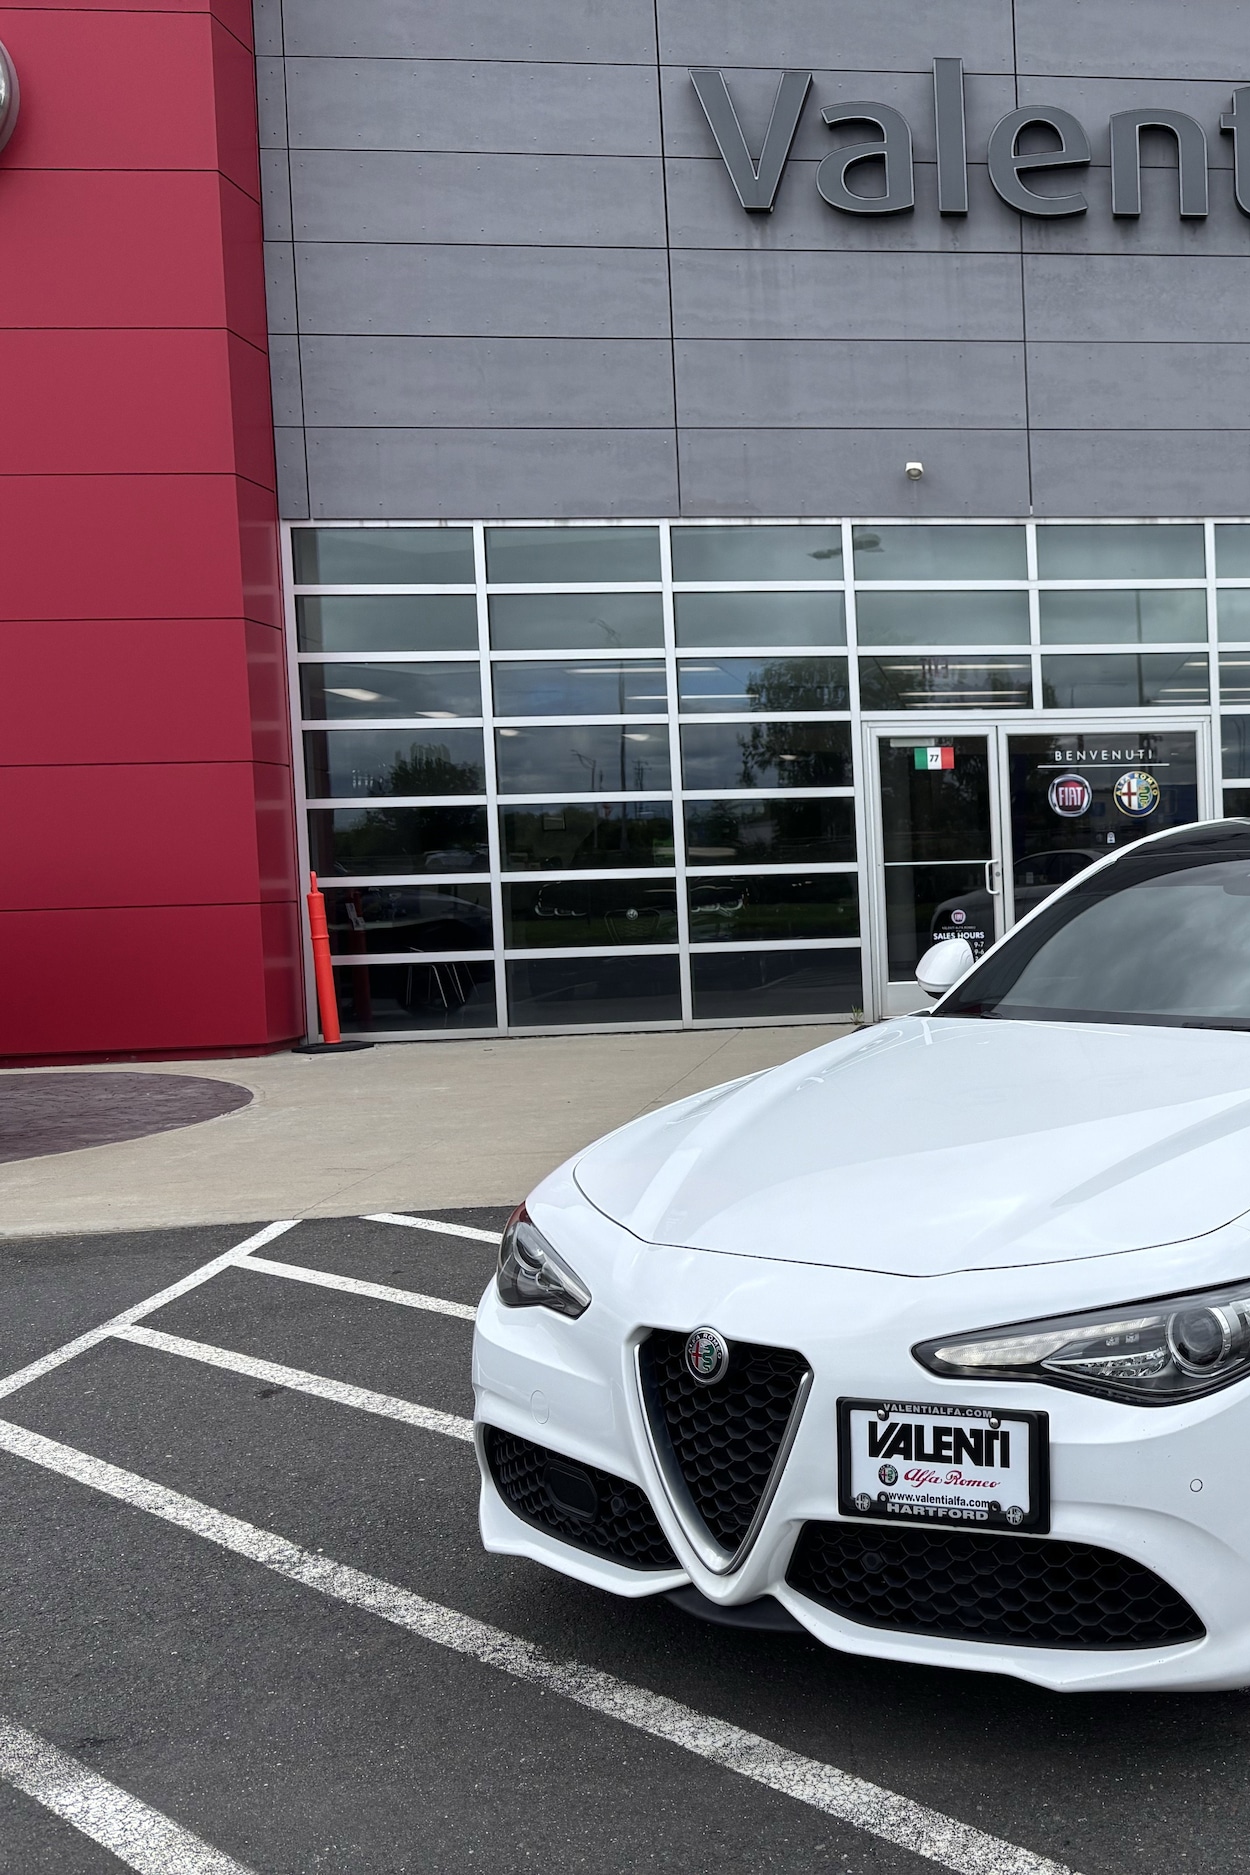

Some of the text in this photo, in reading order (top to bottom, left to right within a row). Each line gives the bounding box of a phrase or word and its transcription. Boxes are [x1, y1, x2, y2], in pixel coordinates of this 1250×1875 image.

[929, 754, 939, 762] 77
[1055, 749, 1152, 761] BENVENUTI
[1058, 786, 1083, 806] FIAT
[933, 931, 985, 940] SALES HOURS
[883, 1403, 993, 1418] VALENTIALFA.COM
[868, 1420, 1010, 1468] VALENTI
[904, 1468, 943, 1488] Alfa
[944, 1469, 1000, 1488] Romeo
[888, 1490, 990, 1509] www.valentialfa.com
[886, 1502, 989, 1521] HARTFORD
